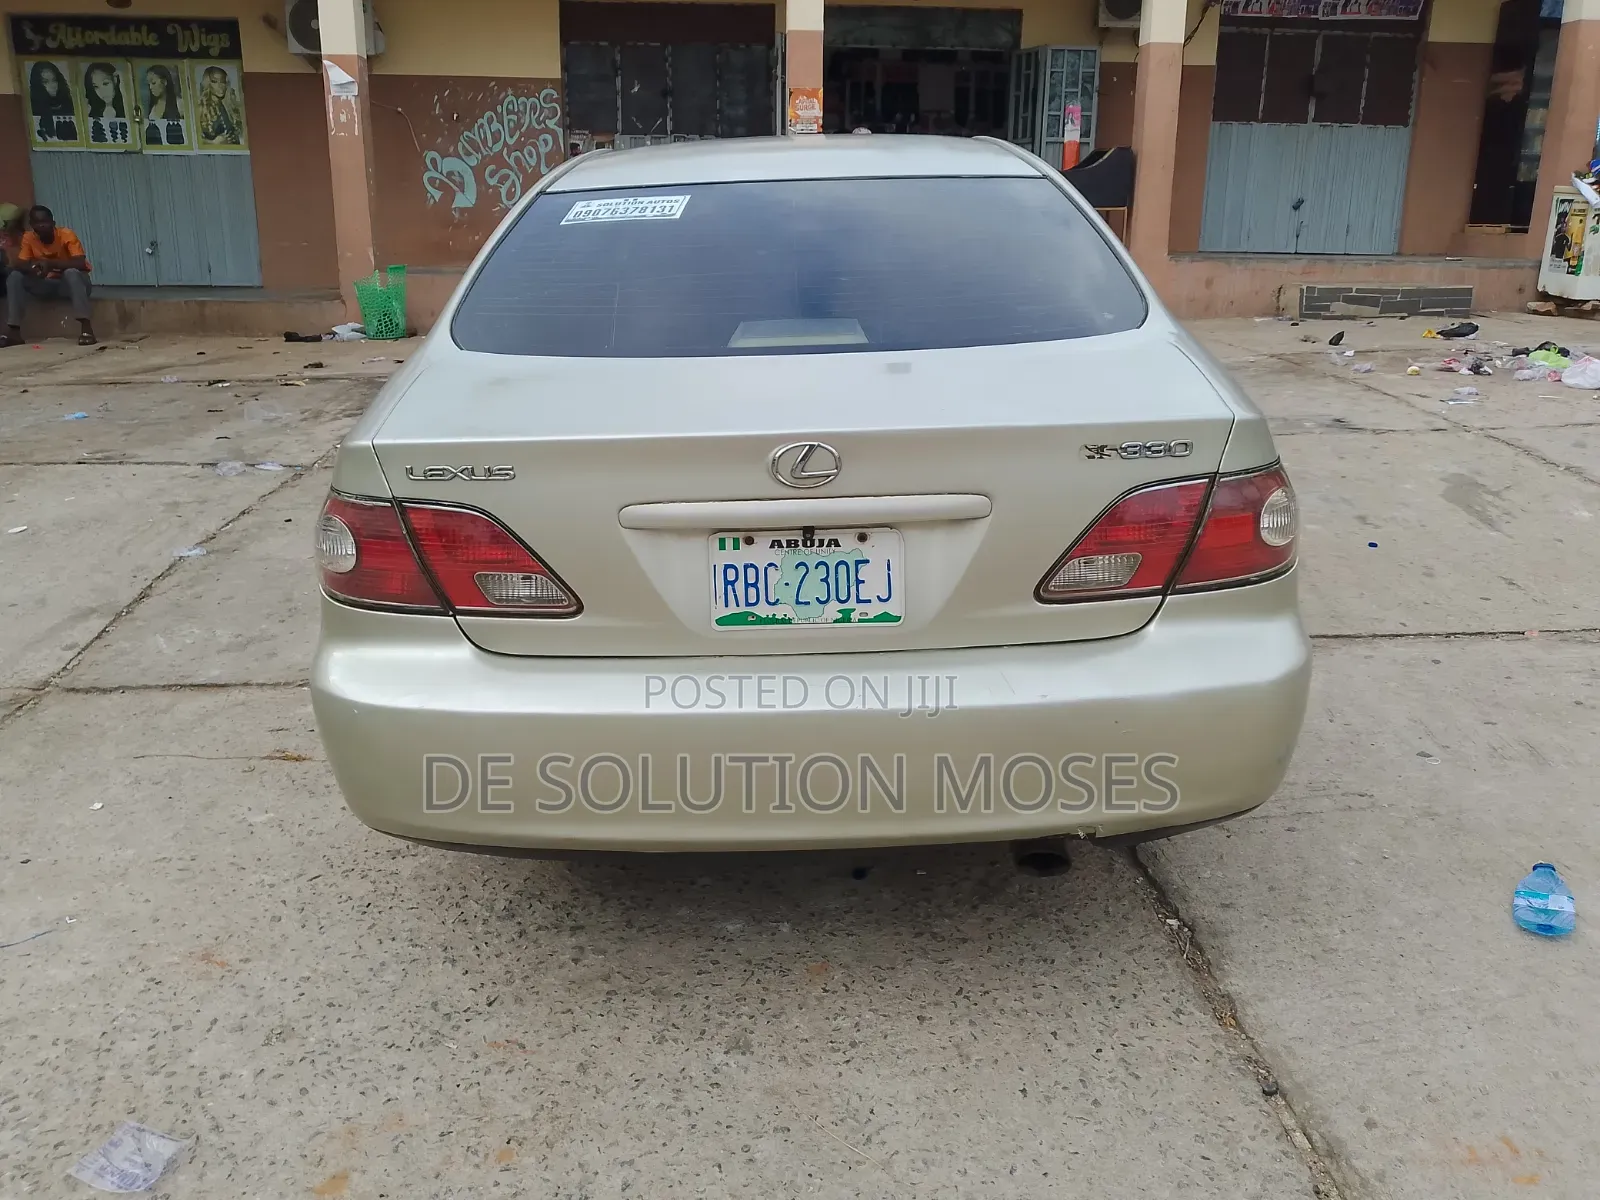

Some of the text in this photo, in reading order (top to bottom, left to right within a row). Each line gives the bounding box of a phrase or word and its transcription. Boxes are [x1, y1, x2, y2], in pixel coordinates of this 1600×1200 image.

[167, 23, 230, 56] Wigs
[1120, 439, 1193, 460] 330
[405, 465, 516, 481] LEXUS
[769, 538, 842, 549] ABUJA
